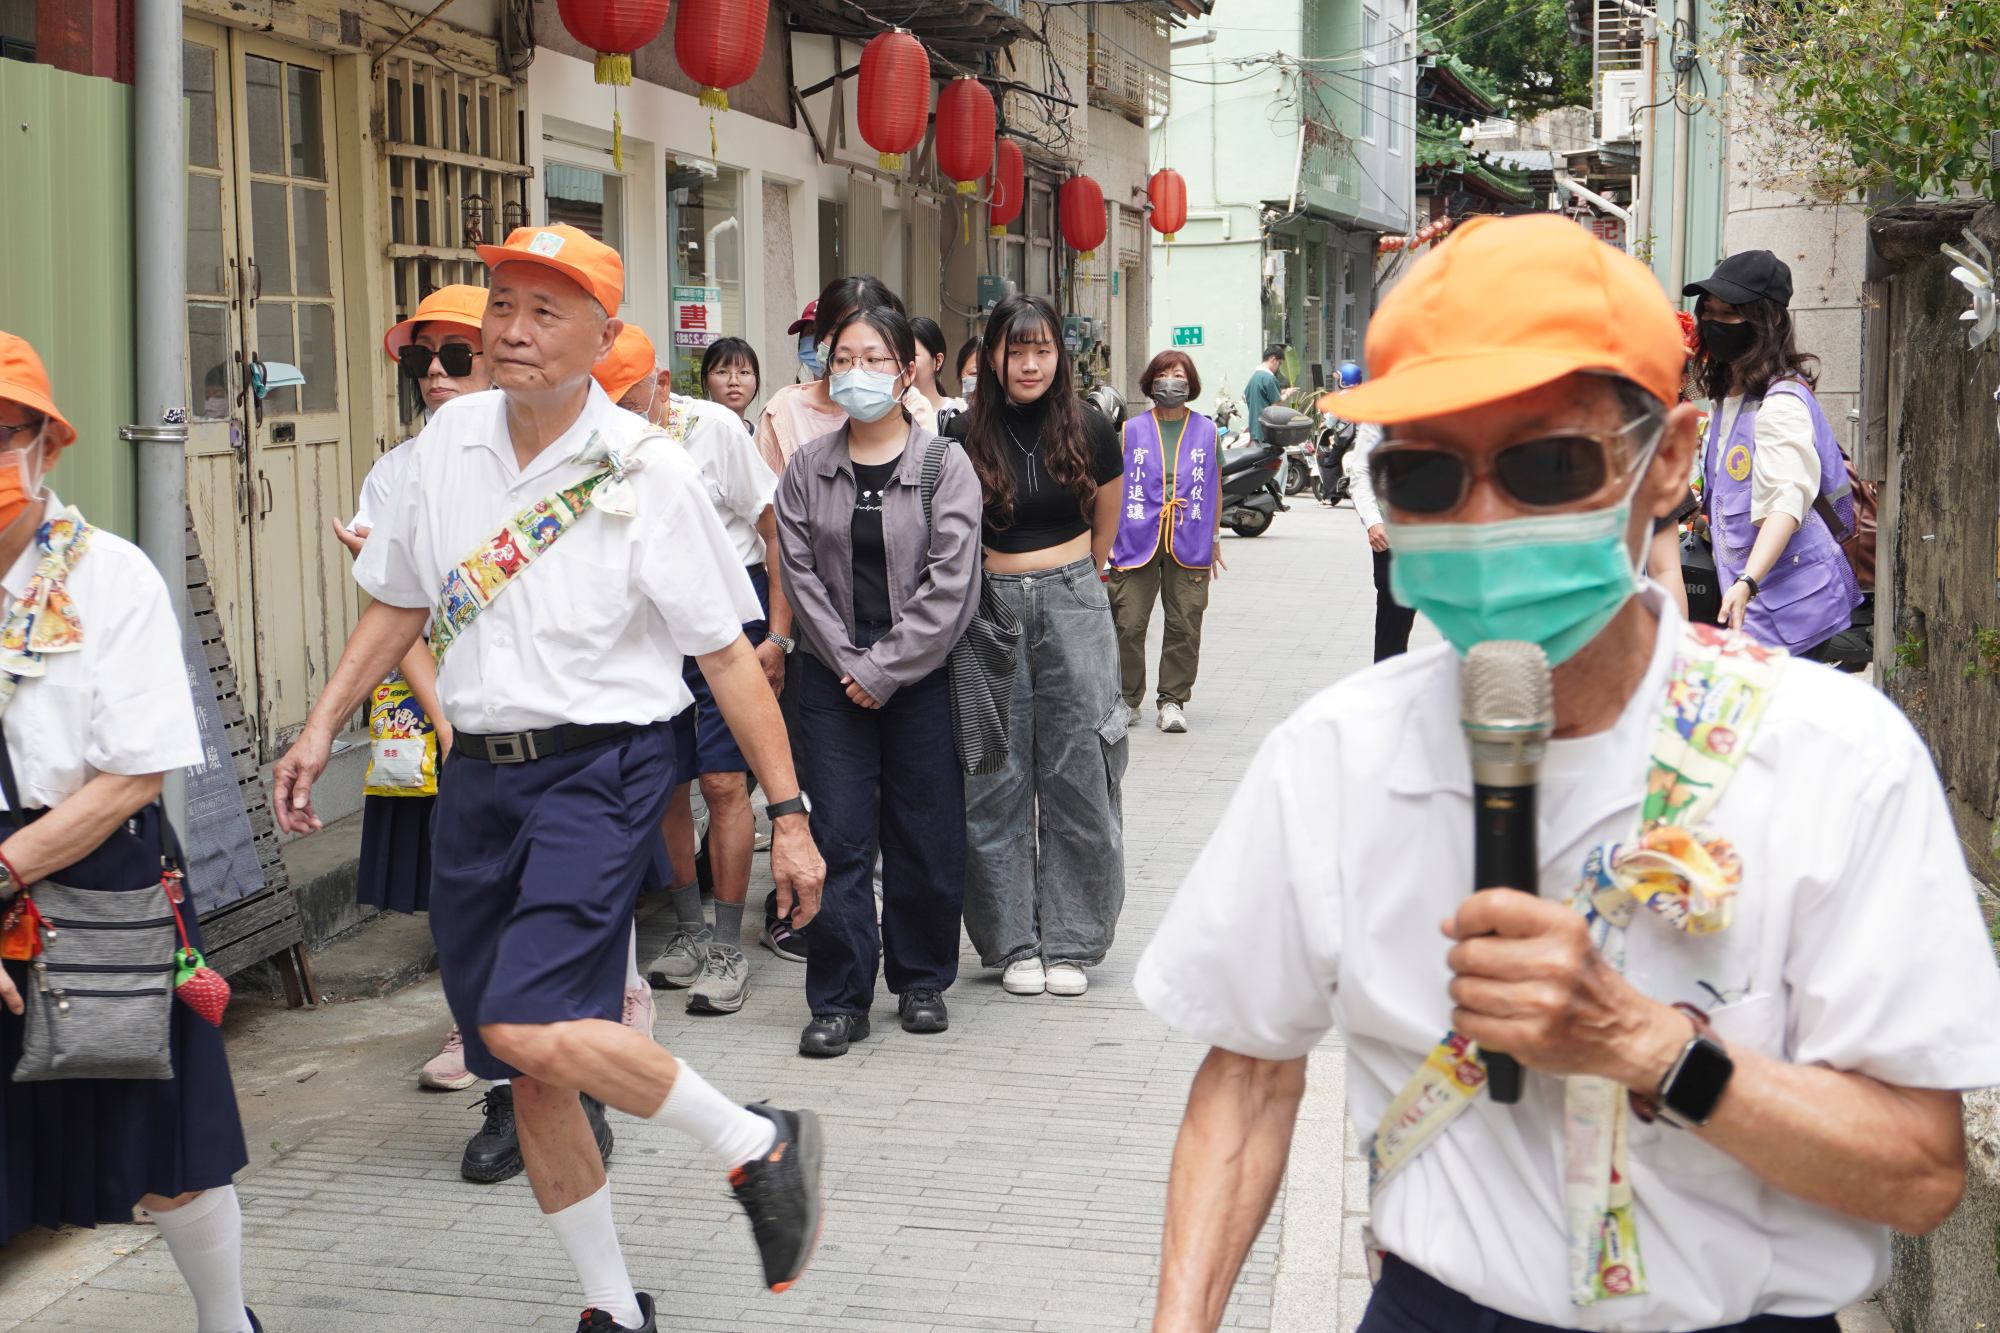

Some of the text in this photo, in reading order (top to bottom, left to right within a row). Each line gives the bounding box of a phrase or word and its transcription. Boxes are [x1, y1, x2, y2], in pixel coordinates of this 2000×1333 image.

[1190, 448, 1206, 520] 行俠仗義
[1684, 583, 1706, 595] RO
